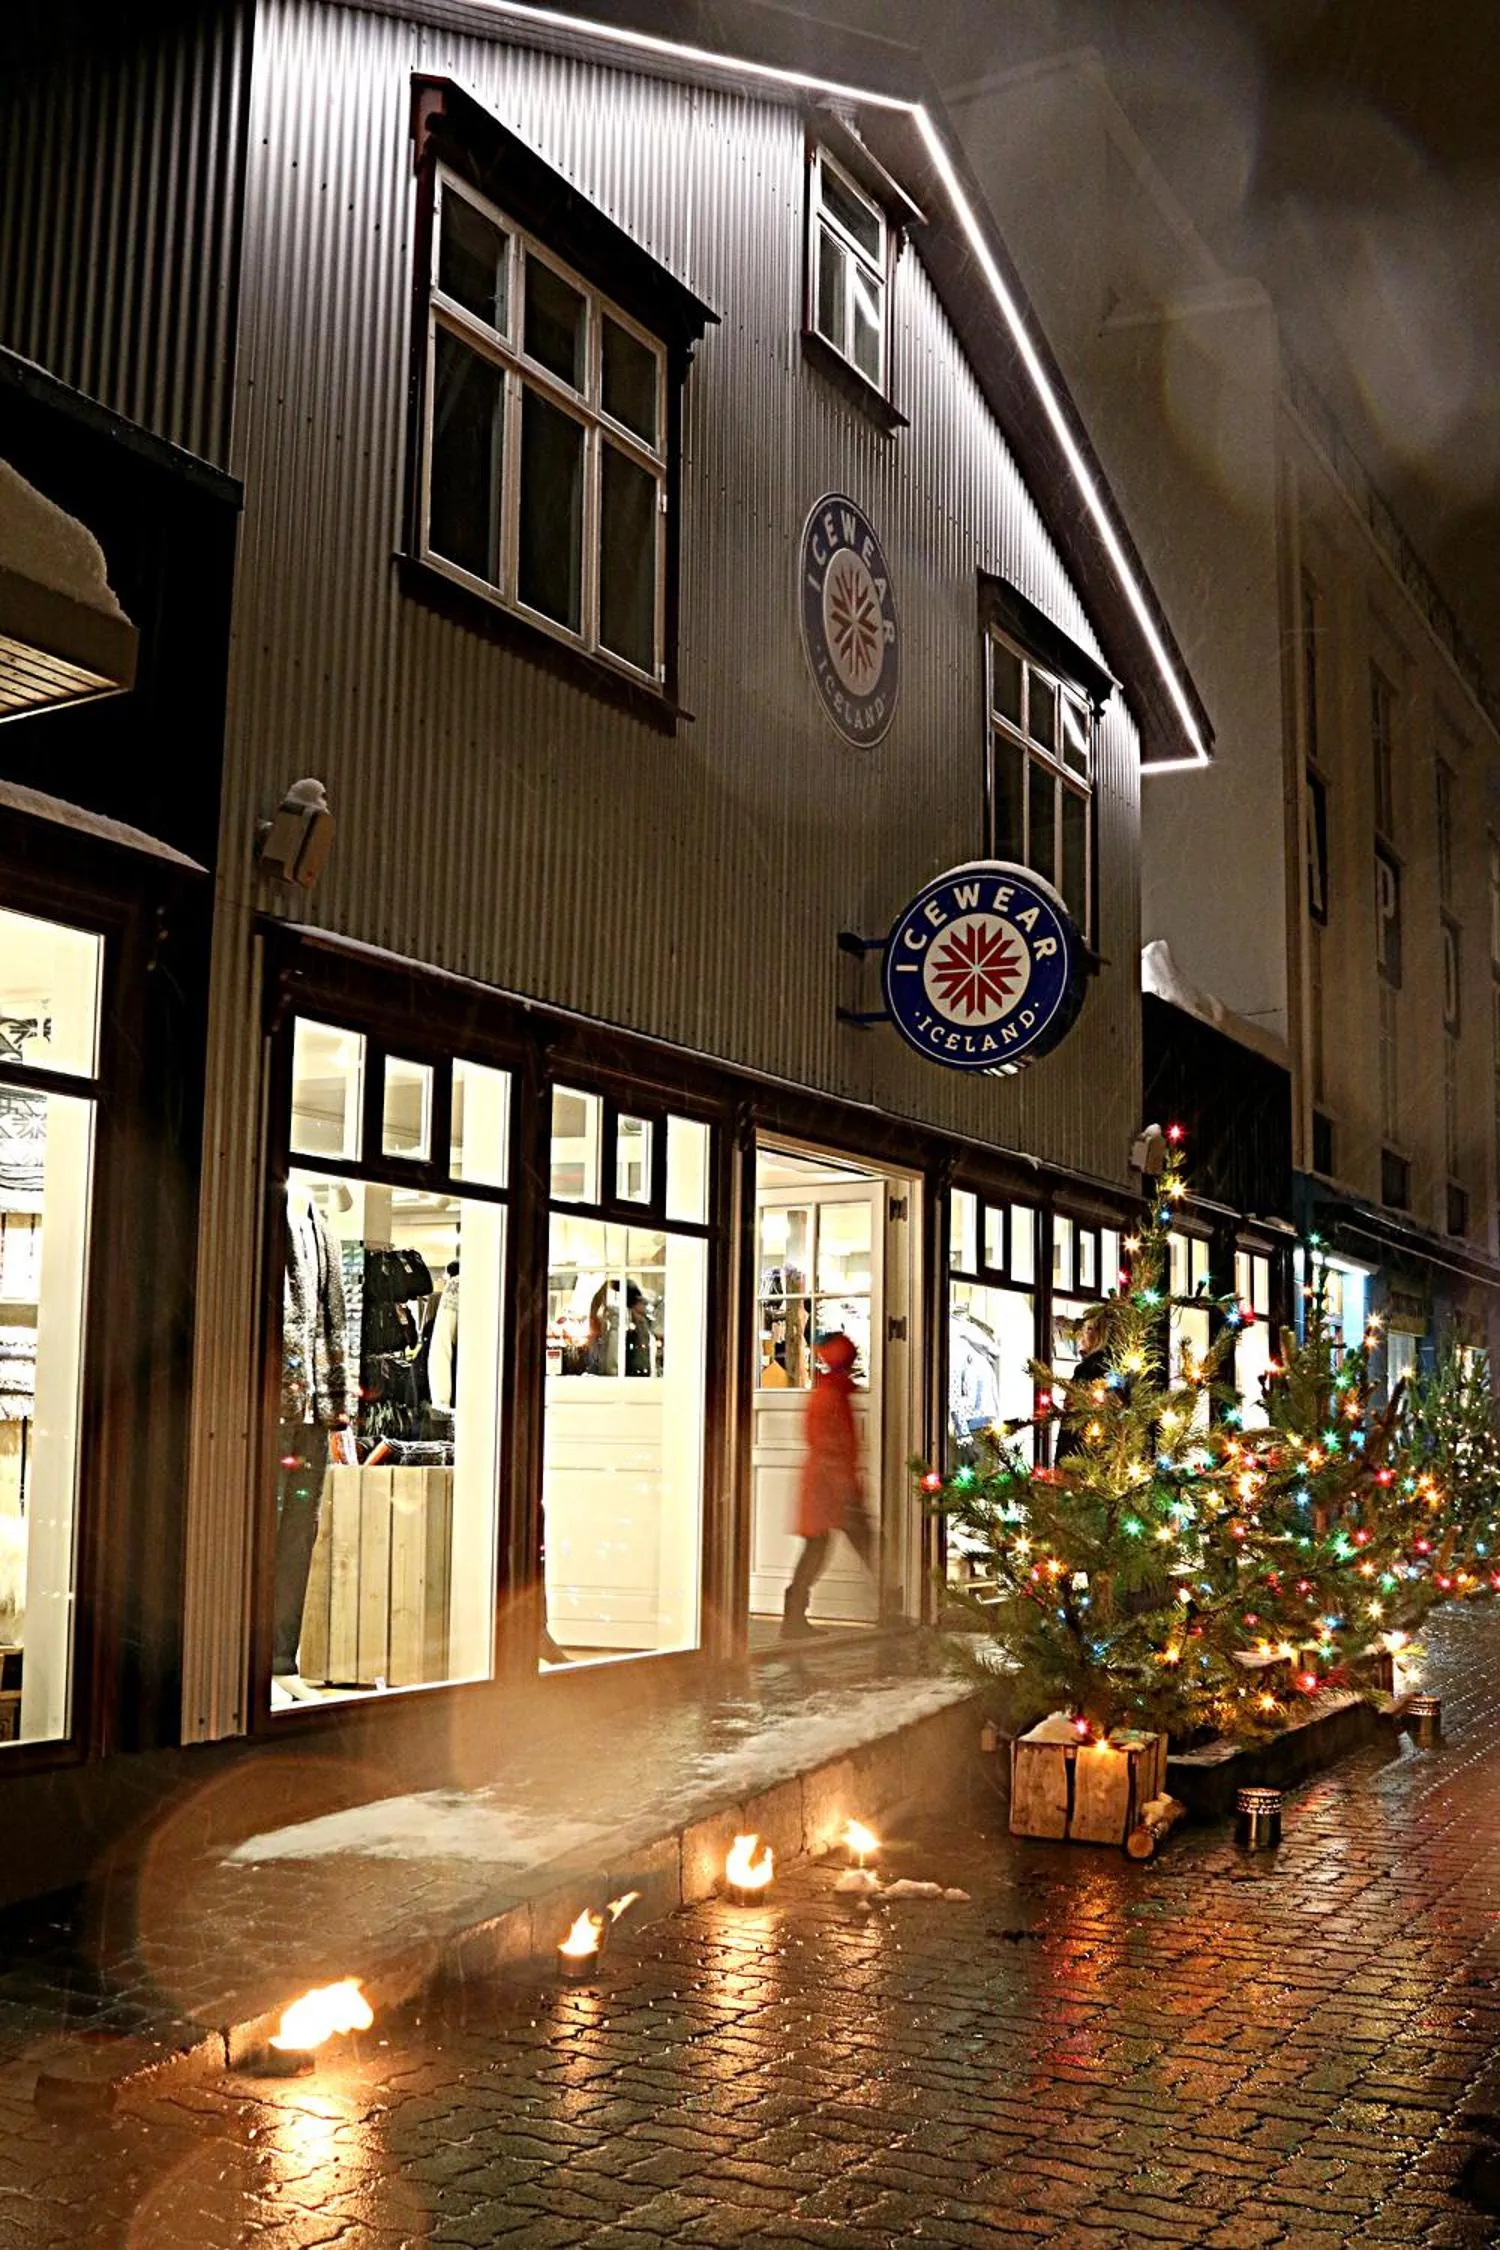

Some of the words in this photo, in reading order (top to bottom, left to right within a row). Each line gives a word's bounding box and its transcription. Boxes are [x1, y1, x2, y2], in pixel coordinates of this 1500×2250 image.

[808, 509, 895, 645] ICEWEAR
[817, 658, 886, 731] ICELAND
[896, 883, 1058, 973] ICEWEAR
[916, 1009, 1037, 1052] ICELAND
